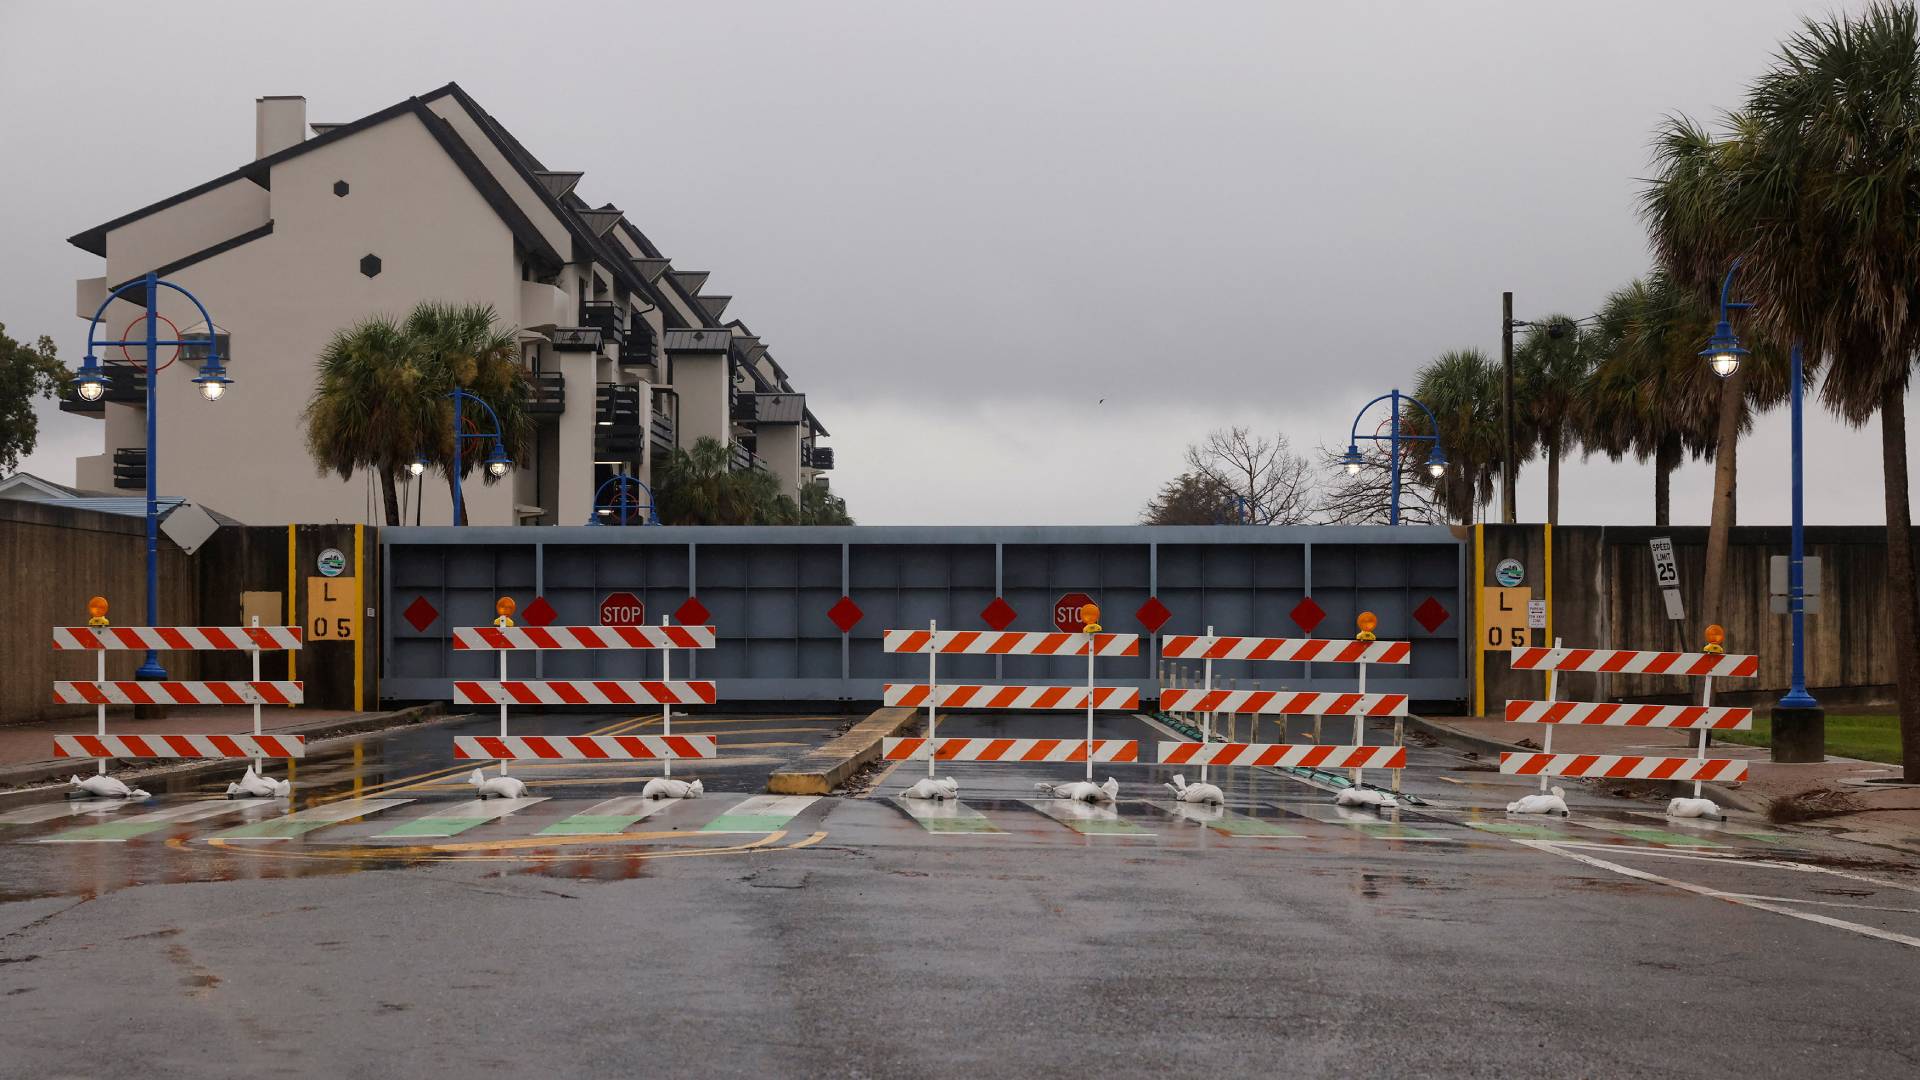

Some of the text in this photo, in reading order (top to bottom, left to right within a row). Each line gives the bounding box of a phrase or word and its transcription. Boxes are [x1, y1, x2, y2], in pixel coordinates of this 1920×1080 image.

[1652, 543, 1670, 552] SPEED
[1656, 553, 1671, 562] LIMIT
[1658, 562, 1676, 581] 25
[324, 582, 337, 602] L
[1499, 592, 1513, 612] L
[602, 606, 641, 623] STOP
[1057, 606, 1084, 623] STO
